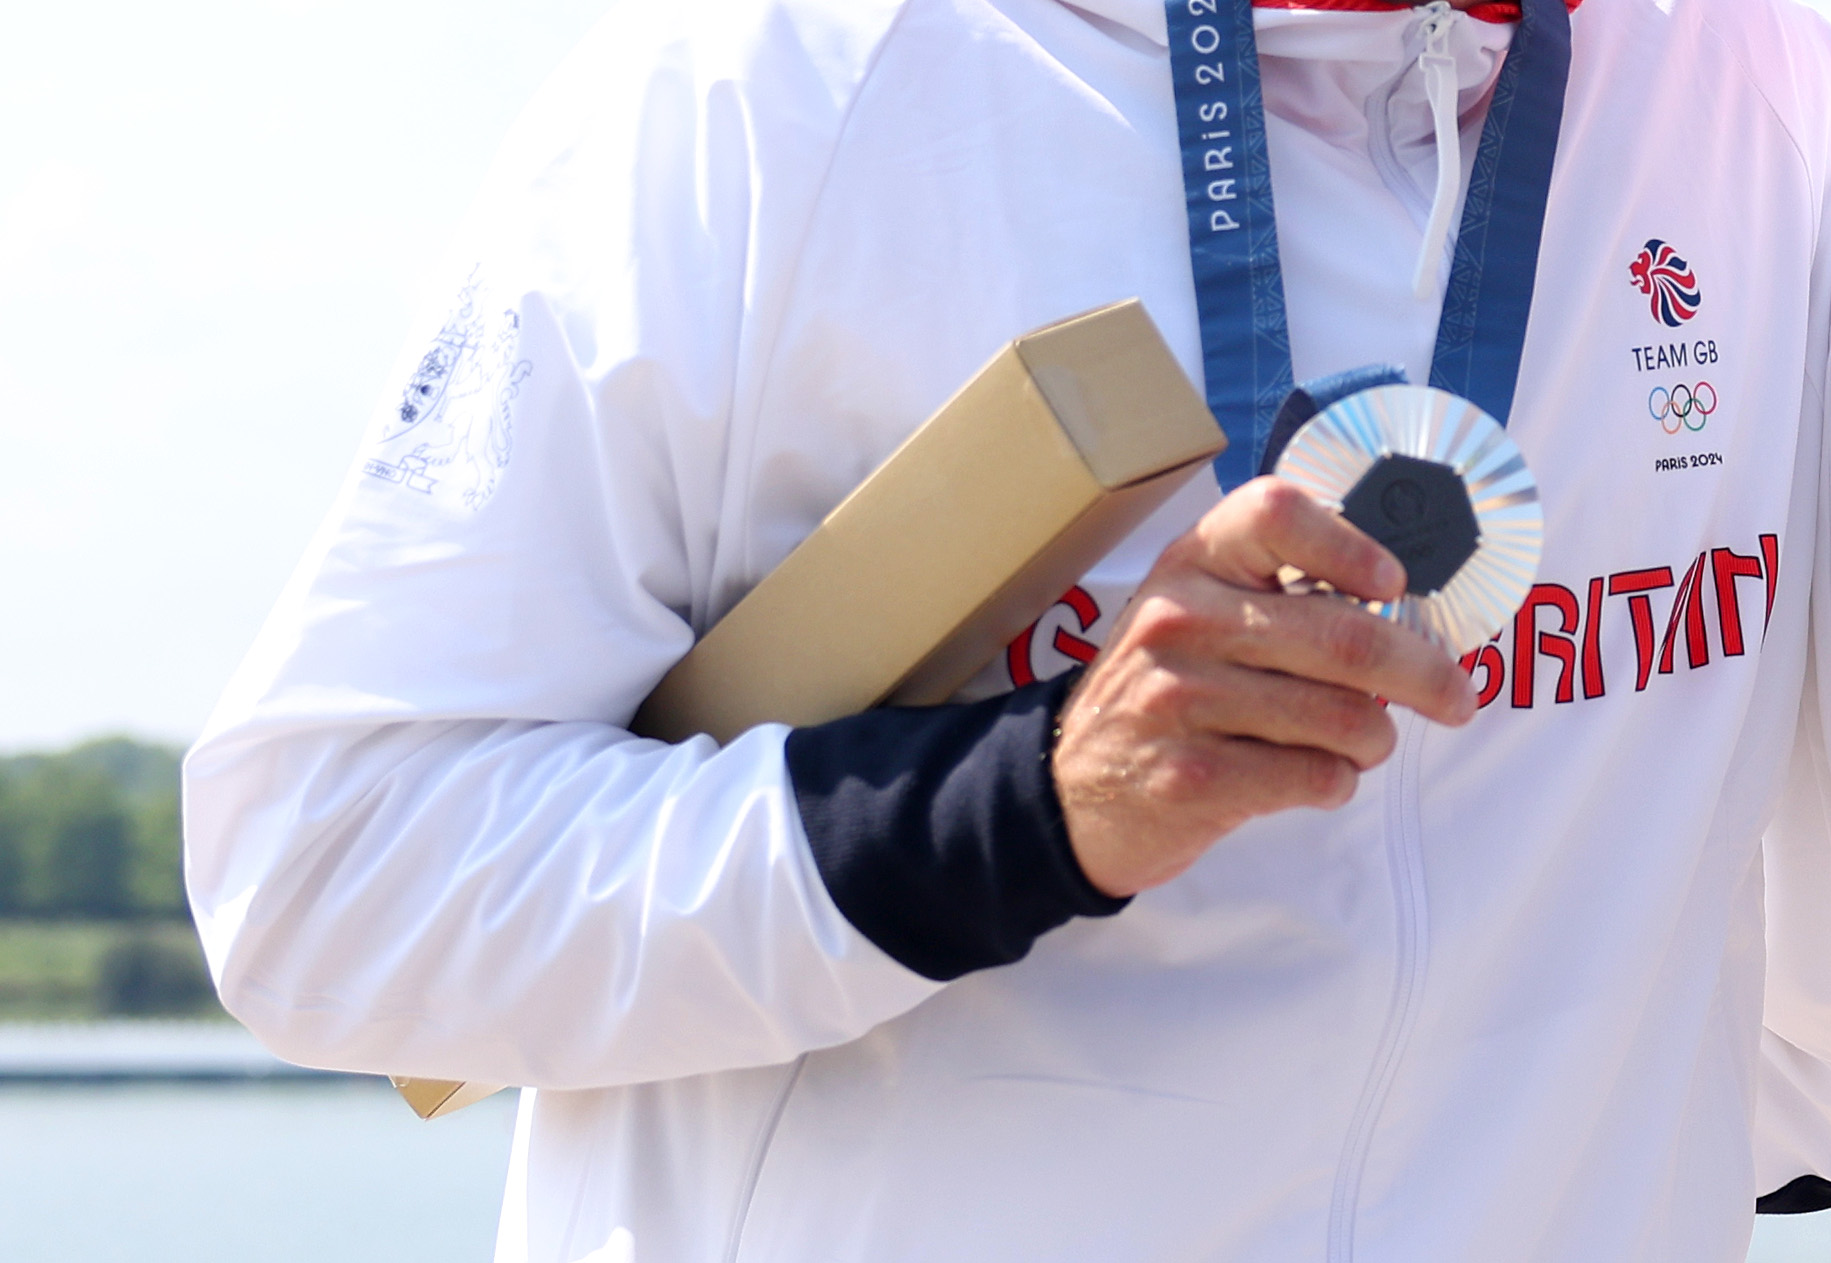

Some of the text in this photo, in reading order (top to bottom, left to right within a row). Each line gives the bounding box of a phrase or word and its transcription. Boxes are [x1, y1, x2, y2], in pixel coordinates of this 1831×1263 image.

[1632, 340, 1718, 372] TEAM GB
[1690, 452, 1723, 468] 2024
